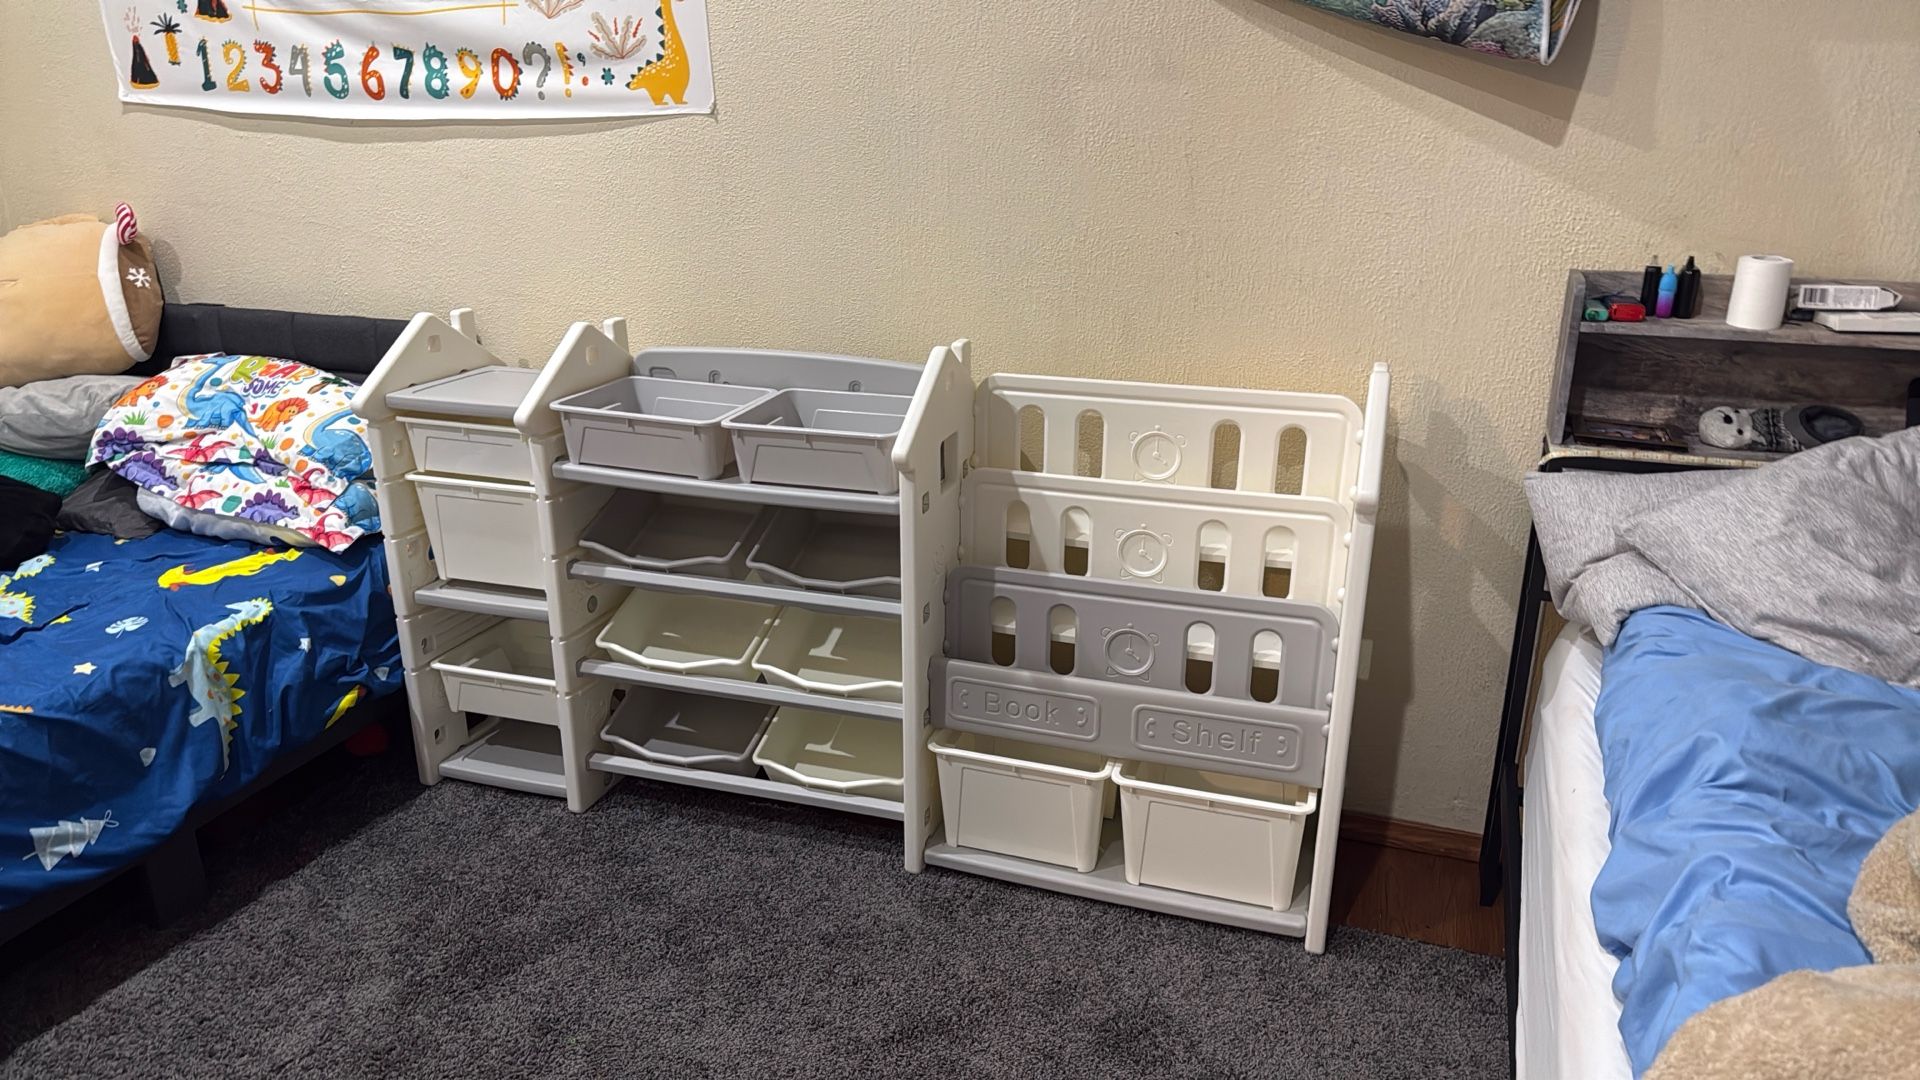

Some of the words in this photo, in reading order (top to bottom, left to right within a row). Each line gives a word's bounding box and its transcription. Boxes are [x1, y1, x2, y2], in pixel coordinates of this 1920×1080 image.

[243, 378, 285, 395] SOME
[984, 691, 1060, 726] Book
[1171, 719, 1262, 755] Shelf
